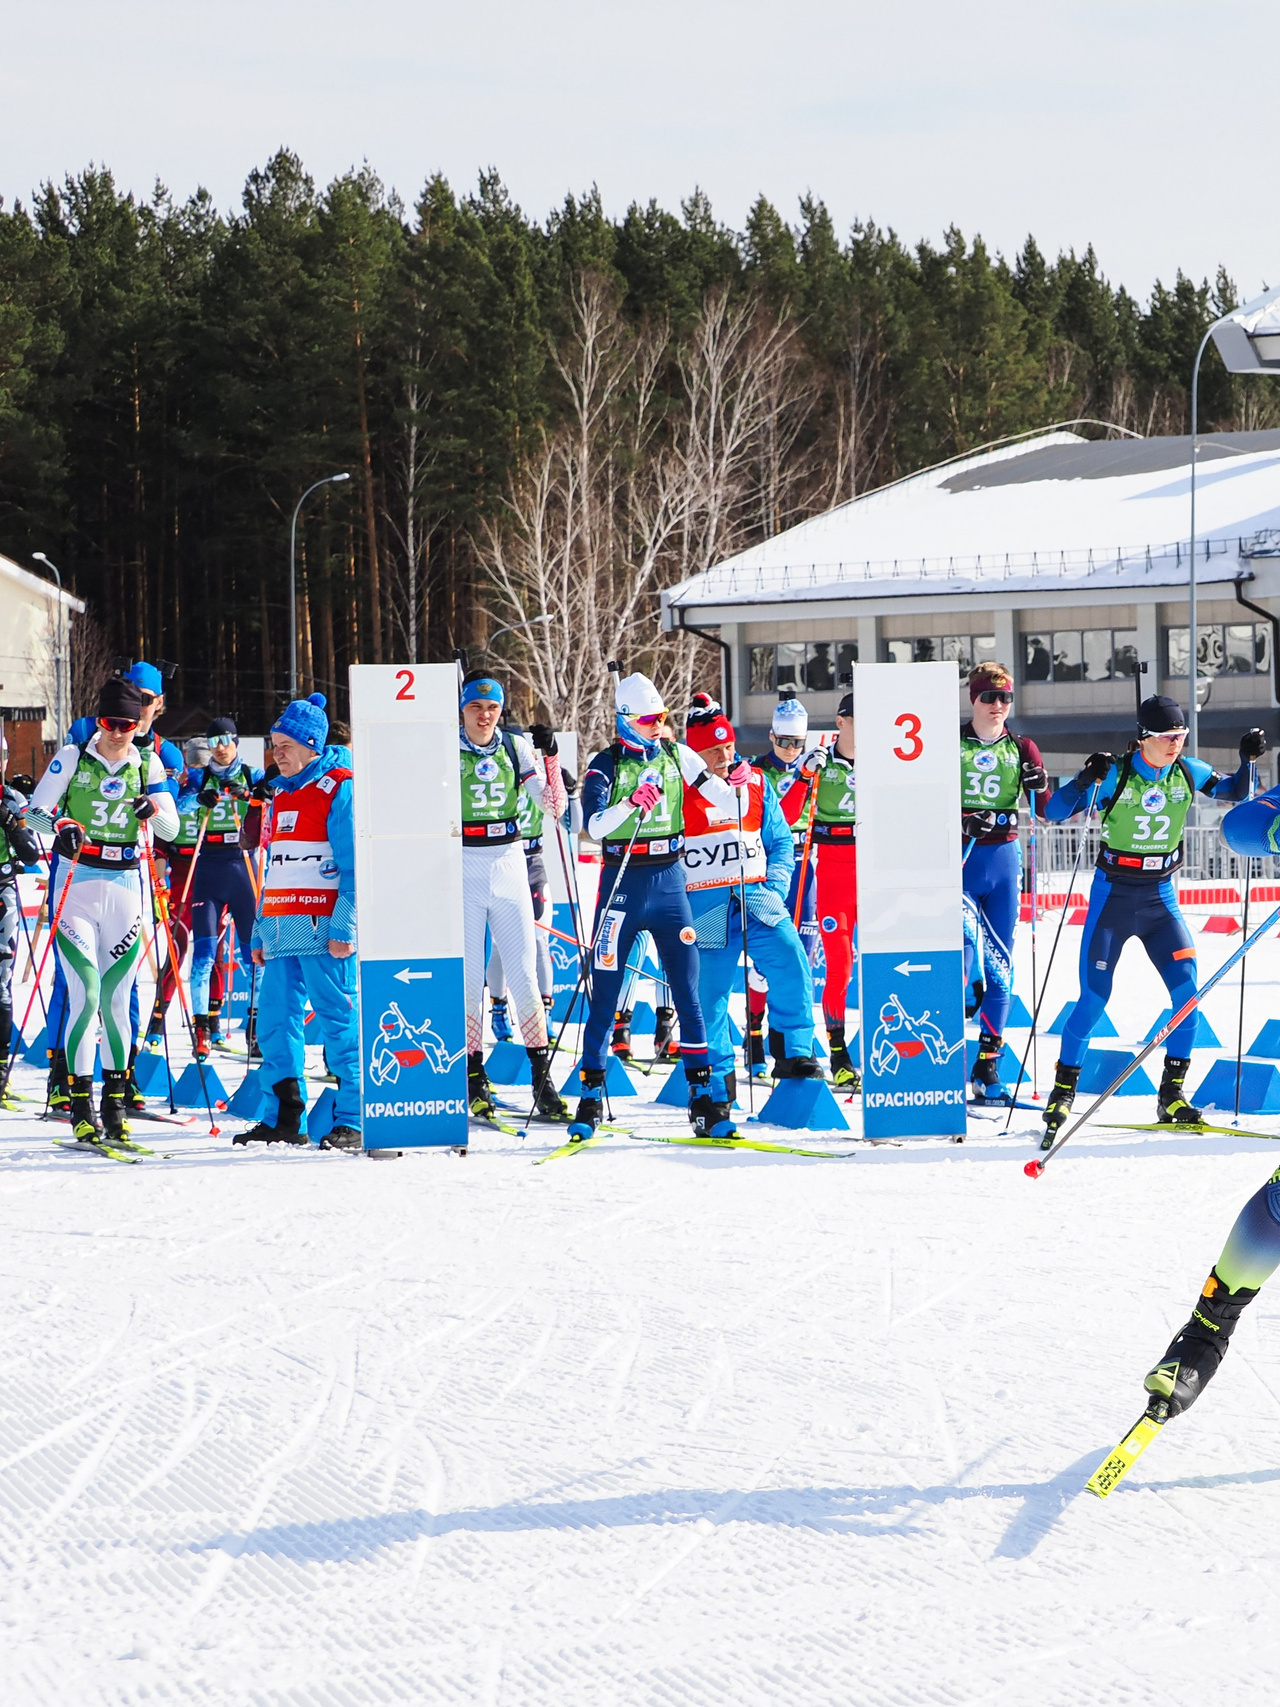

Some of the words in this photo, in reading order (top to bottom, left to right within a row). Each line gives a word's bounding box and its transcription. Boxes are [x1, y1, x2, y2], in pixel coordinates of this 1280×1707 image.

[395, 670, 415, 701] 2
[893, 713, 923, 762] 3
[470, 782, 506, 809] 35
[965, 771, 1001, 799] 36
[90, 800, 129, 828] 34
[213, 800, 241, 821] 51
[1132, 815, 1171, 841] 32
[298, 893, 327, 905] край
[59, 918, 90, 951] ЮГОРИЯ
[365, 1099, 466, 1118] КРАСНОЯРСК
[865, 1089, 964, 1108] КРАСНОЯРСК
